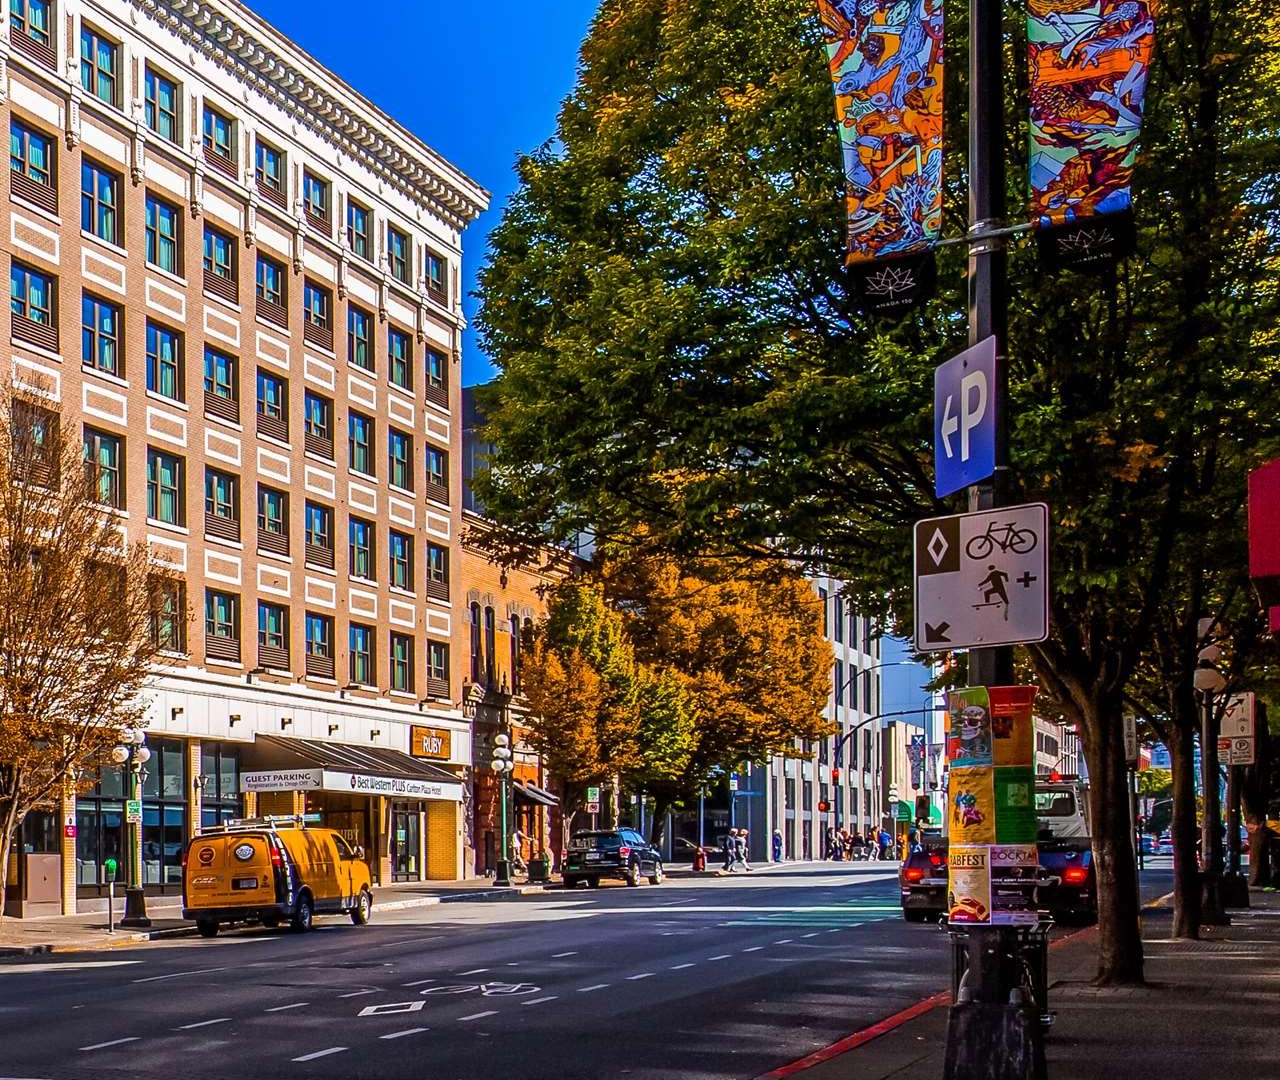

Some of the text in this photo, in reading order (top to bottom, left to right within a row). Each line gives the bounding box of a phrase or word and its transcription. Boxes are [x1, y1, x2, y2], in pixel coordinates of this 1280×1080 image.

[961, 370, 987, 462] P
[423, 736, 442, 754] RUBY
[245, 773, 311, 783] GUEST PARKING
[357, 776, 370, 789] Best
[370, 778, 391, 790] Western
[392, 779, 406, 792] PLUS
